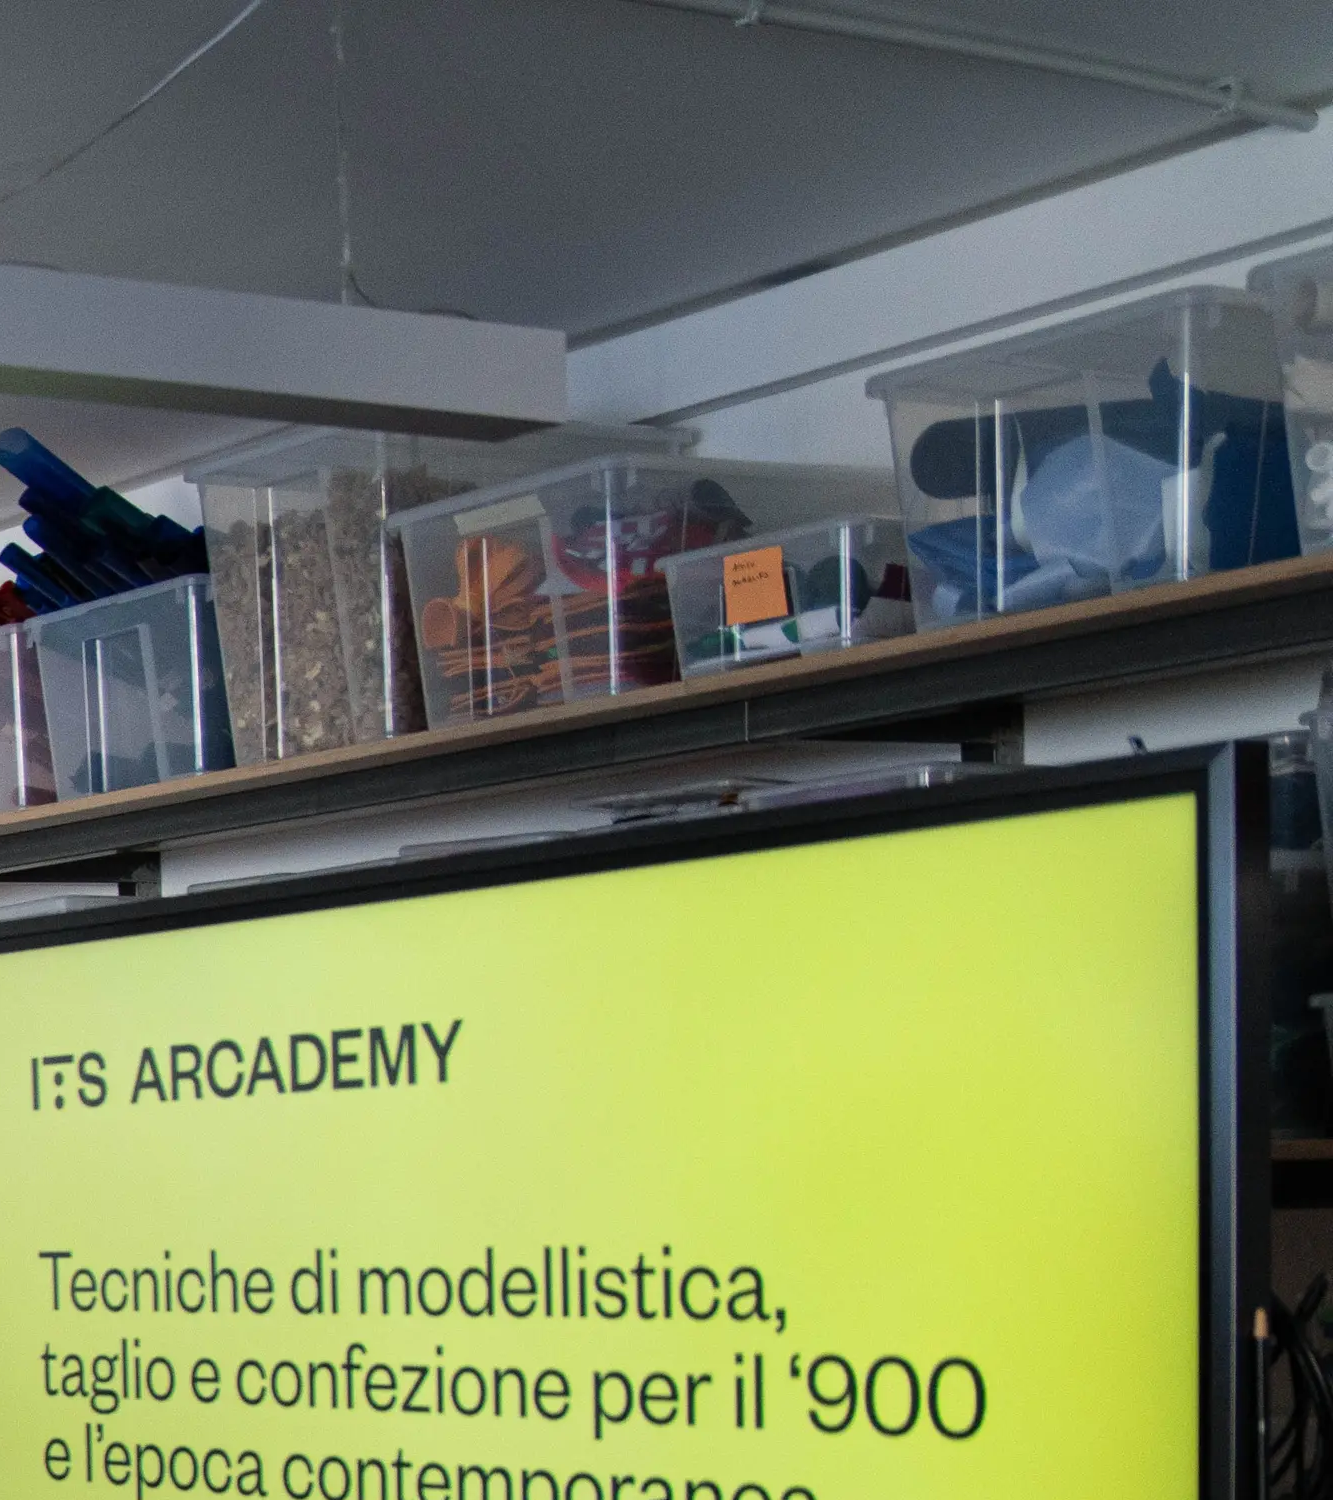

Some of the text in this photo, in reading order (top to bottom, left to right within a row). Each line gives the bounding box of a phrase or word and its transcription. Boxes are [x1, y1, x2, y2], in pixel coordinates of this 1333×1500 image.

[32, 1019, 463, 1111] ITS ARCADEMY
[39, 1245, 787, 1334] Tecniche di modellistica,
[40, 1338, 176, 1415] taglio
[190, 1357, 221, 1404] e
[236, 1342, 571, 1421] confezione
[593, 1369, 713, 1440] per
[734, 1353, 764, 1430] il
[44, 1437, 71, 1481] e
